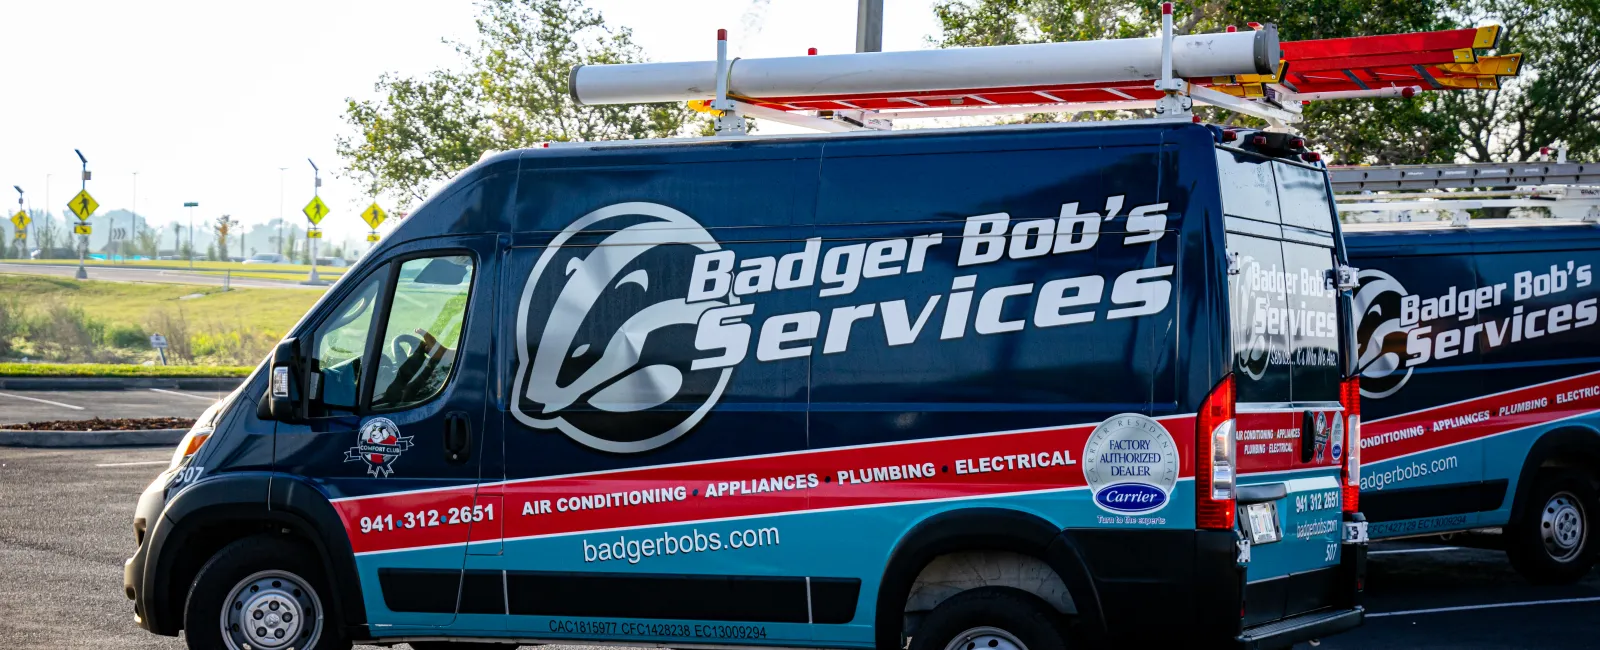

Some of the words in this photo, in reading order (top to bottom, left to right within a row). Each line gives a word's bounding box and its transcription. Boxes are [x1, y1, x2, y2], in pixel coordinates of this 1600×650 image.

[686, 233, 942, 303] Badger
[957, 195, 1169, 267] Bob's
[1251, 262, 1299, 300] Badger
[1400, 281, 1507, 327] Badger
[1513, 260, 1592, 301] Bob's
[691, 265, 1174, 371] Services
[1255, 301, 1336, 338] Services
[1405, 297, 1598, 367] Services
[1244, 429, 1274, 440] CONDITIONING
[1277, 428, 1300, 439] APPLIANCES
[1360, 425, 1424, 449] ONDITIONING
[1433, 410, 1490, 432] APPLIANCES
[1498, 397, 1548, 417] PLUMBING
[1088, 427, 1110, 483] CARRIER
[1117, 419, 1173, 481] RESIDENTIAL
[1100, 452, 1161, 464] AUTHORIZED
[1109, 440, 1151, 450] FACTORY
[1244, 444, 1266, 455] PLUMBING
[1269, 443, 1293, 453] ELECTRICAL
[176, 466, 204, 483] 507
[522, 500, 552, 516] AIR
[556, 486, 687, 512] CONDITIONING
[704, 473, 819, 498] APPLIANCES
[837, 462, 936, 485] PLUMBING
[955, 450, 1076, 475] ELECTRICAL
[1110, 466, 1151, 476] DEALER
[1360, 456, 1458, 490] adgerbobs.com
[1106, 490, 1157, 503] Carrier
[1296, 494, 1308, 513] 941
[1310, 493, 1322, 510] 312
[1324, 491, 1339, 508] 2651
[1297, 518, 1338, 541] badgerbobs.com
[583, 526, 780, 564] badgerbobs.com
[1325, 543, 1338, 561] 507
[549, 619, 617, 634] CAC1815977
[621, 621, 690, 637] CFC1428238
[695, 624, 767, 639] EC13009294
